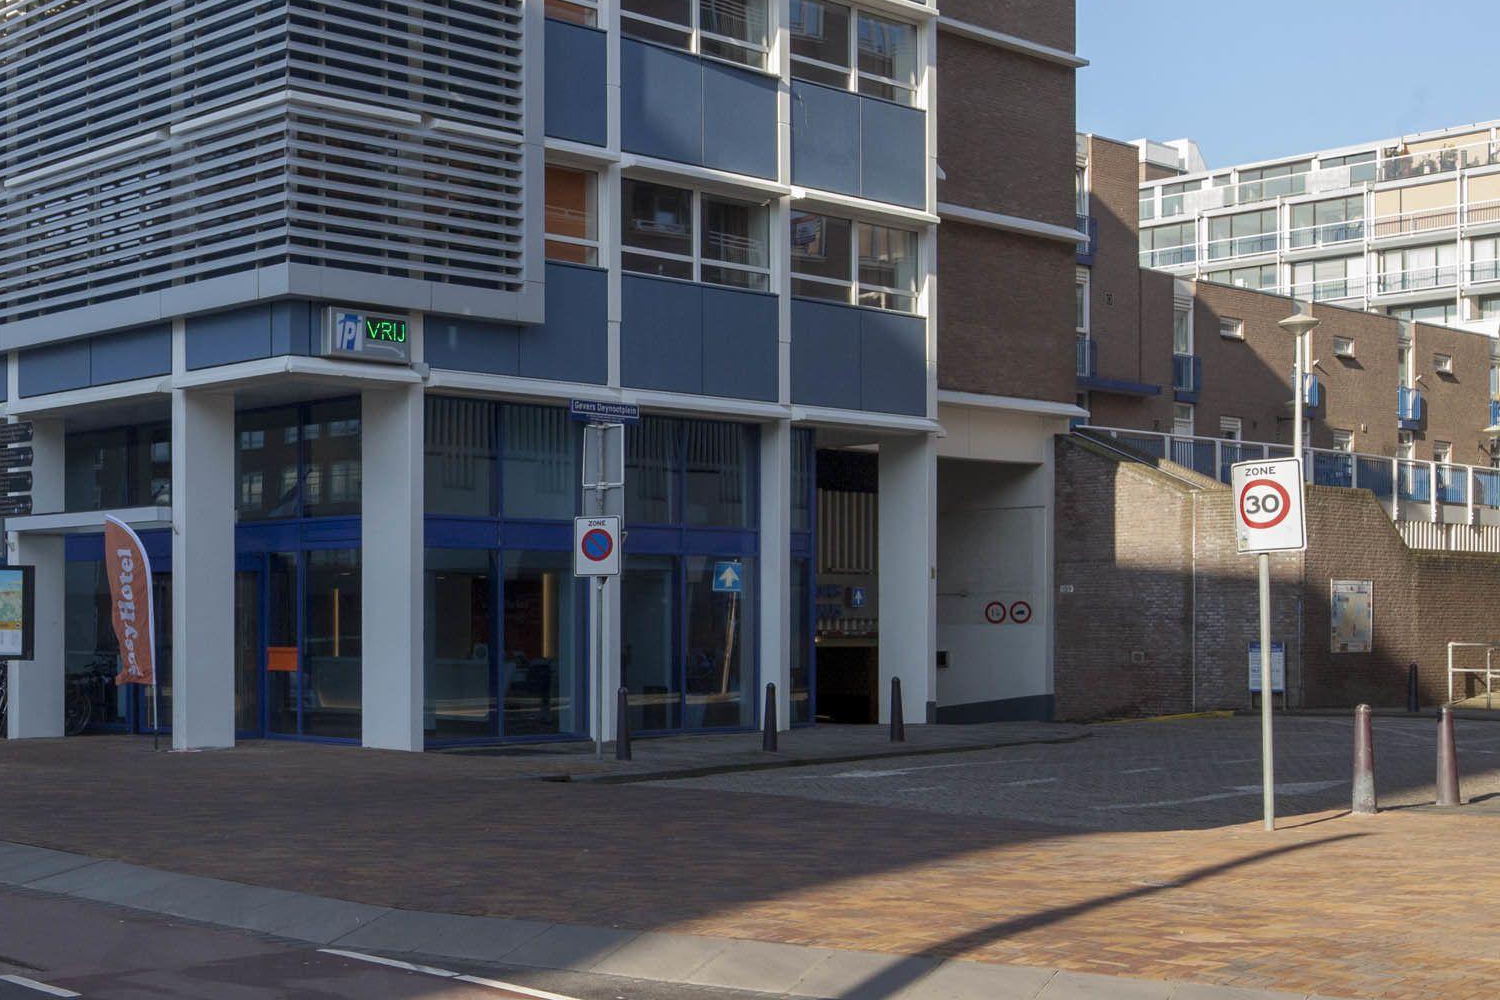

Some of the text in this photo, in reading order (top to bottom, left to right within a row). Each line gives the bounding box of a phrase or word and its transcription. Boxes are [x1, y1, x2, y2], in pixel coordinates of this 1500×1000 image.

[366, 320, 405, 342] VRIJ
[574, 400, 596, 411] Gevers
[1245, 466, 1276, 477] ZONE
[1245, 494, 1280, 515] 30
